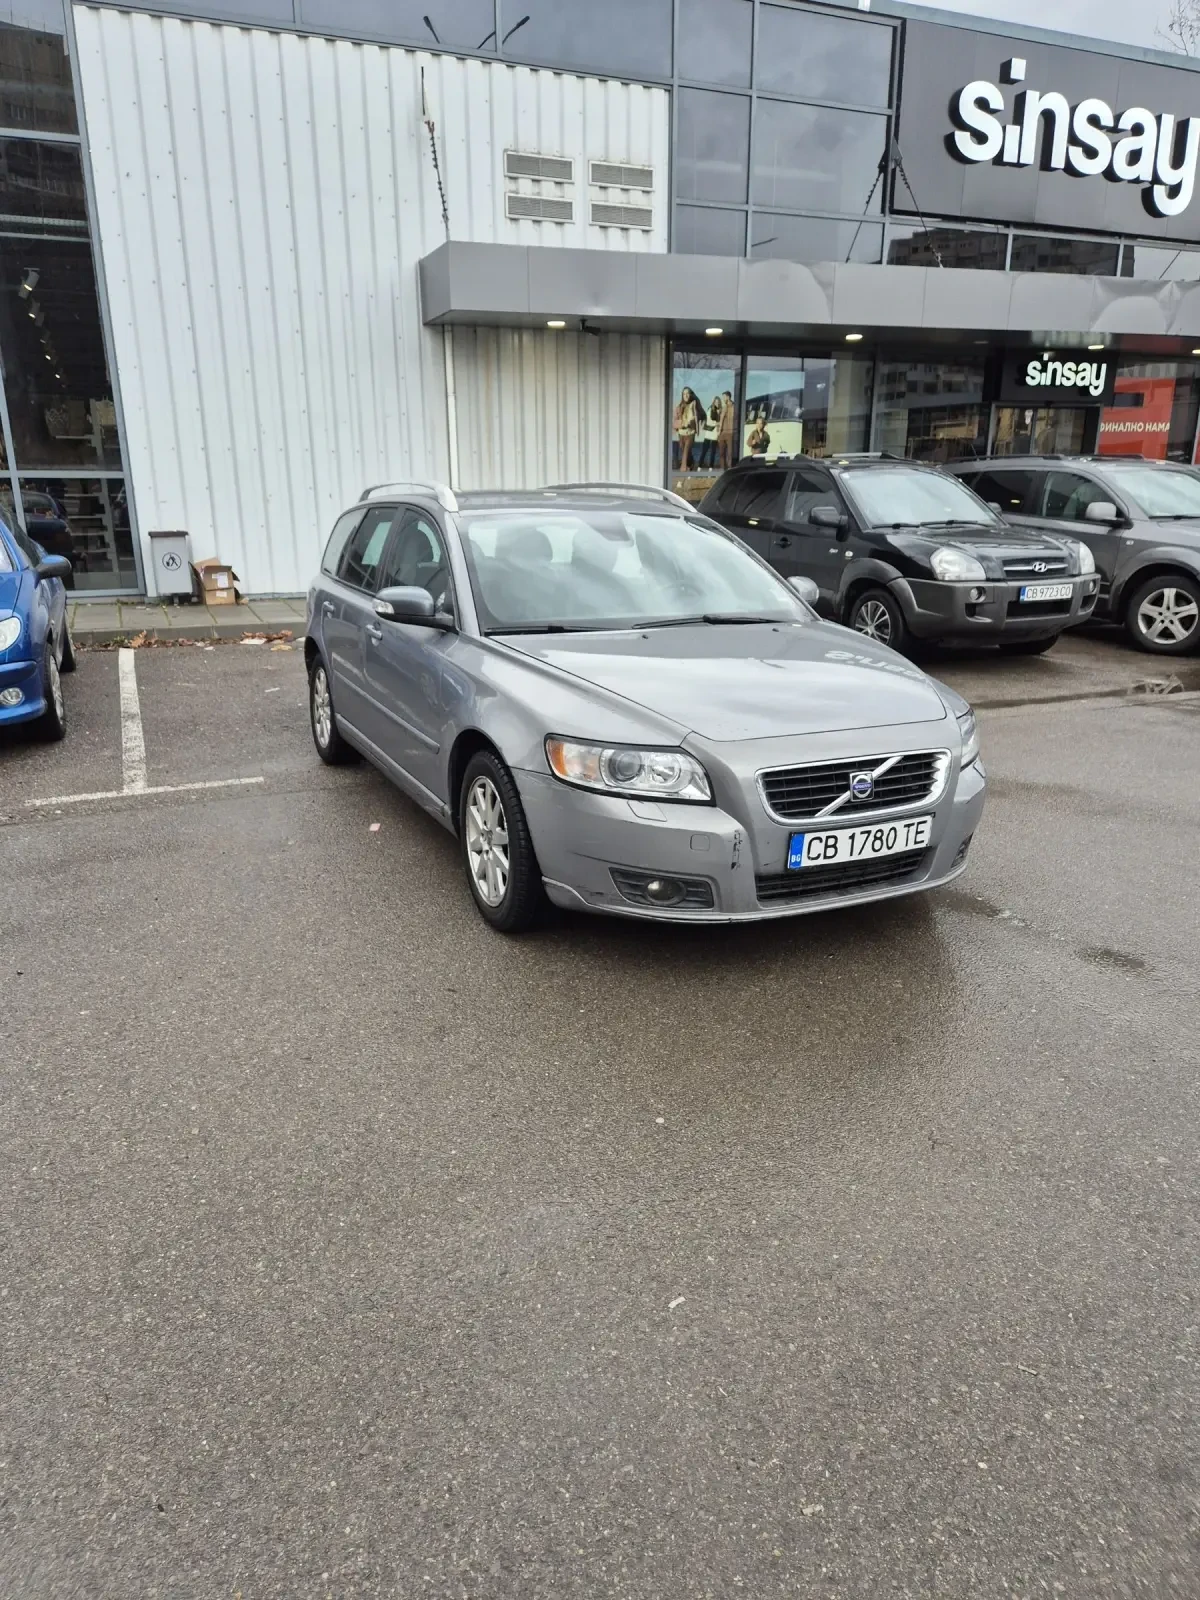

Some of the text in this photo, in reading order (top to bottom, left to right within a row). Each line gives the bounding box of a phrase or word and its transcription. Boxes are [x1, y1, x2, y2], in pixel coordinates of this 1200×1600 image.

[954, 57, 1200, 216] sinsay
[1025, 353, 1107, 396] sinsay
[1040, 587, 1059, 598] 9723
[806, 820, 928, 861] CB 1780 TE
